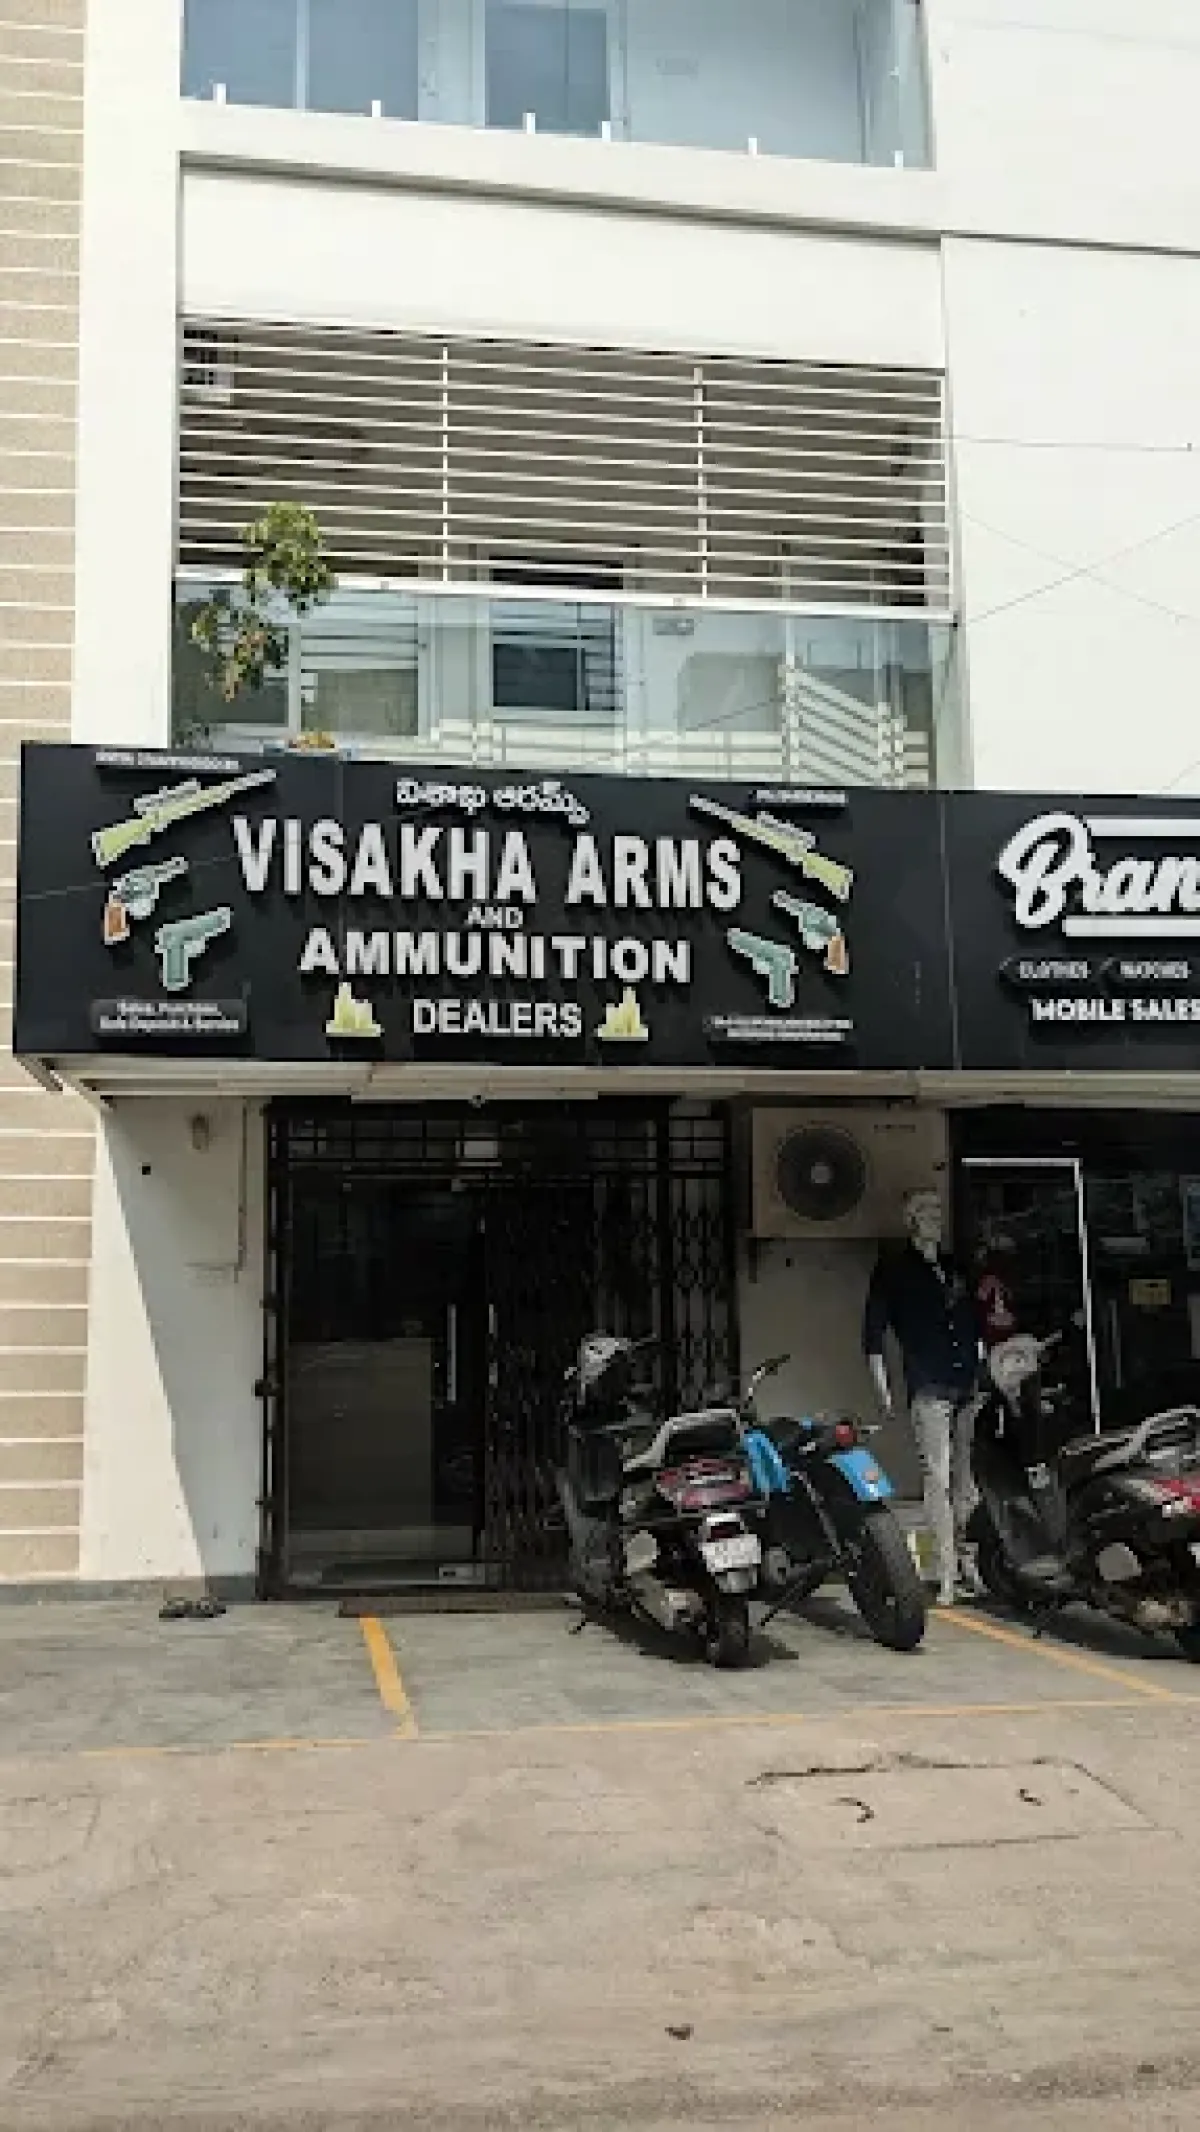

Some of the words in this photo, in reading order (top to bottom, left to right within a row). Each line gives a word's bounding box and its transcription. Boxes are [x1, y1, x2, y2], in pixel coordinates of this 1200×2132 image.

[233, 815, 536, 904] VISAKHA
[565, 831, 743, 912] ARMS
[464, 906, 524, 929] AND
[299, 927, 691, 984] AMMUNITION
[413, 998, 583, 1038] DEALERS
[1031, 998, 1127, 1022] MOBILE
[1130, 998, 1200, 1022] SALES
